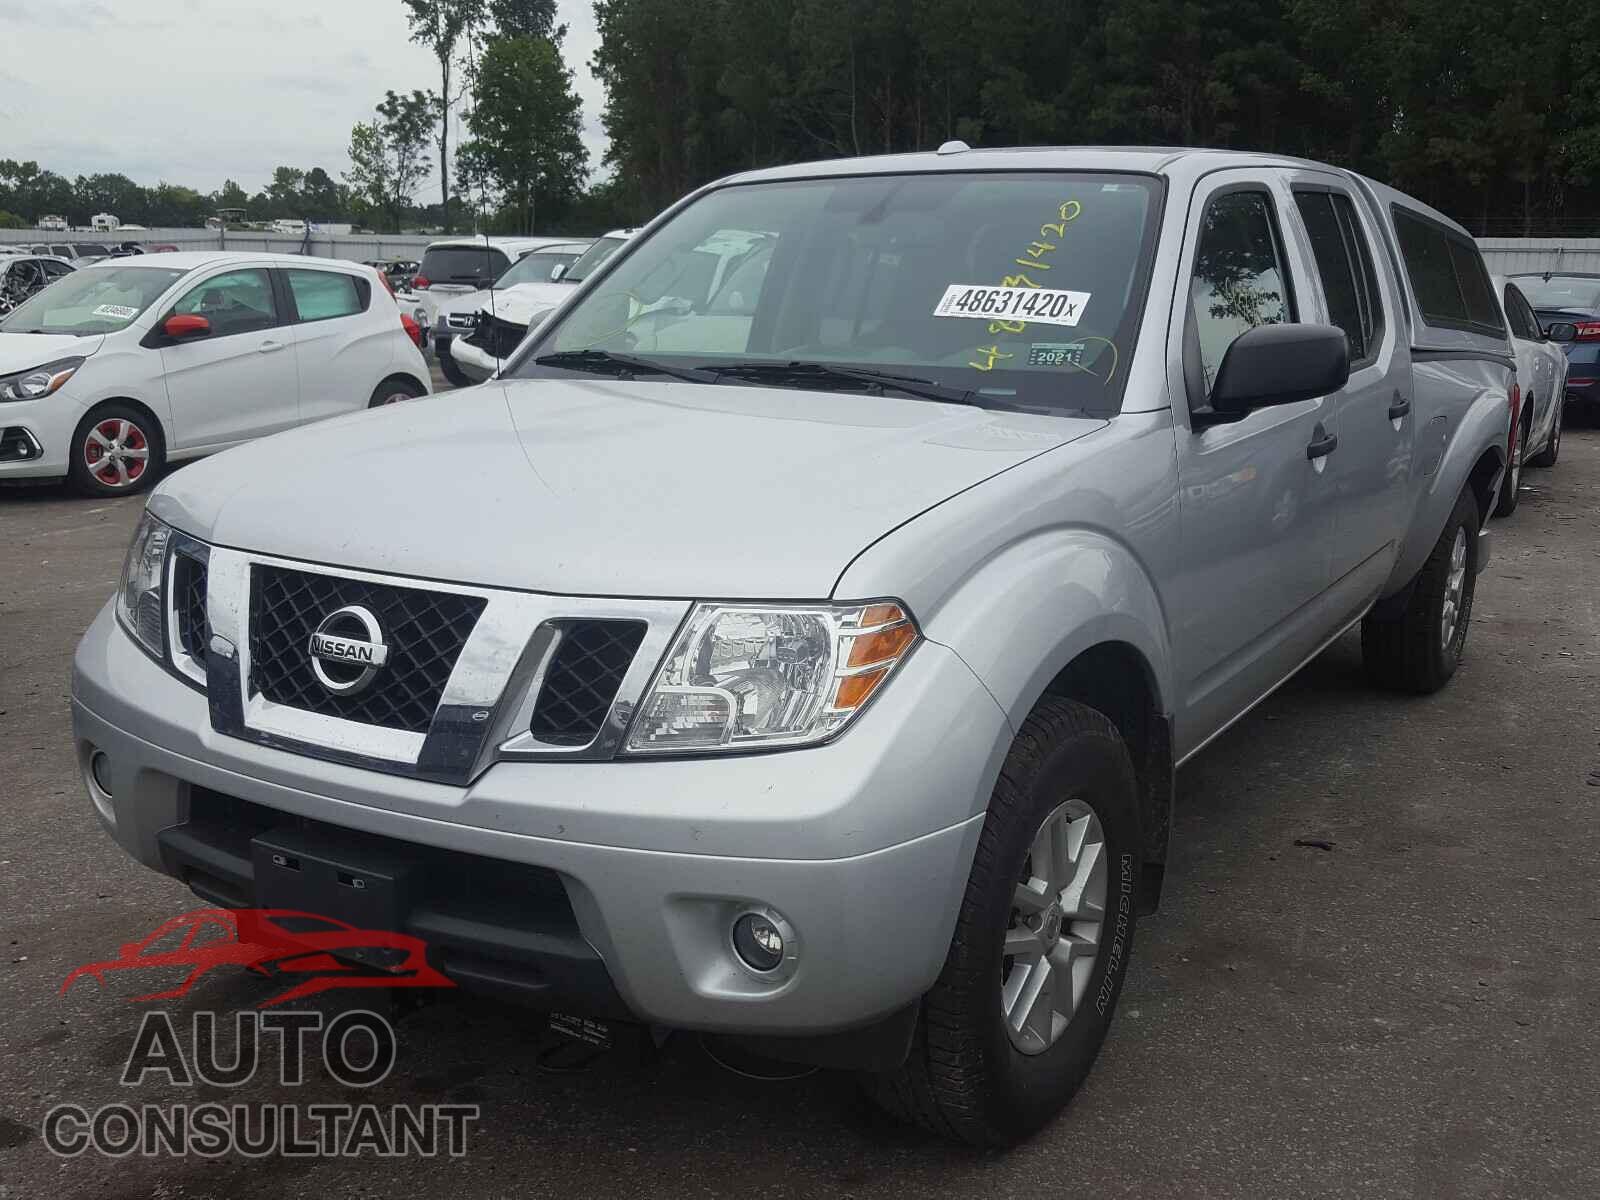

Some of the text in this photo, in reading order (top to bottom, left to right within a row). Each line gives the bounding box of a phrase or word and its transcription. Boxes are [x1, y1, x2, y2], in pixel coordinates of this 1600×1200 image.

[1037, 352, 1073, 363] 2021
[311, 635, 373, 661] NISSAN
[1096, 854, 1133, 1017] MICHELIN
